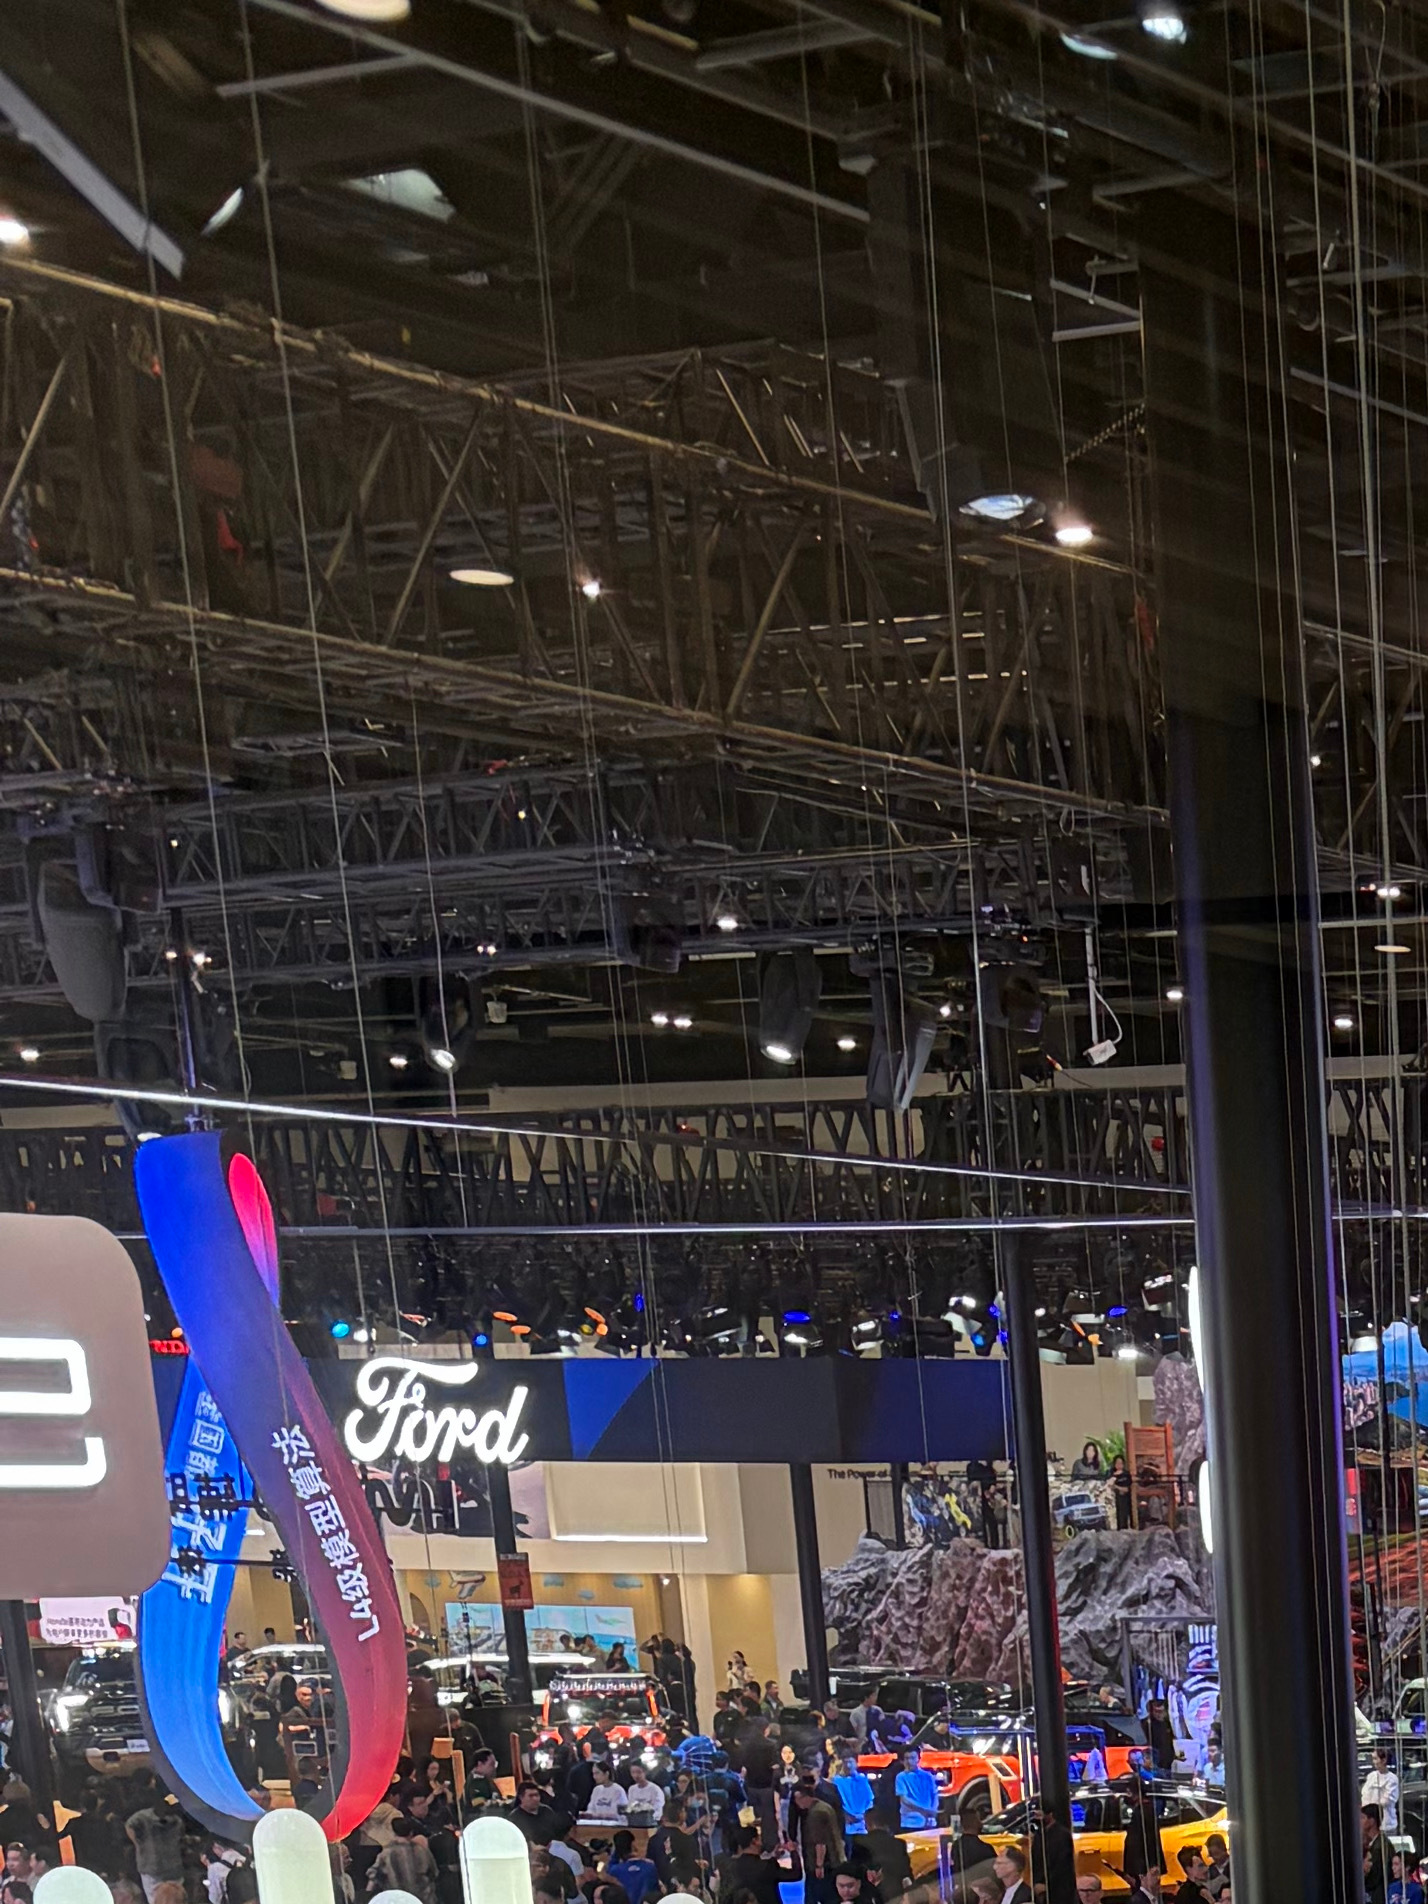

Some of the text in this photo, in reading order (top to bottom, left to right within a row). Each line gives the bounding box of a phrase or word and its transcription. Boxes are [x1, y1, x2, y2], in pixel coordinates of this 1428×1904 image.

[344, 1356, 530, 1464] Ford
[827, 1468, 846, 1479] The
[271, 1424, 381, 1642] L4级模型算法
